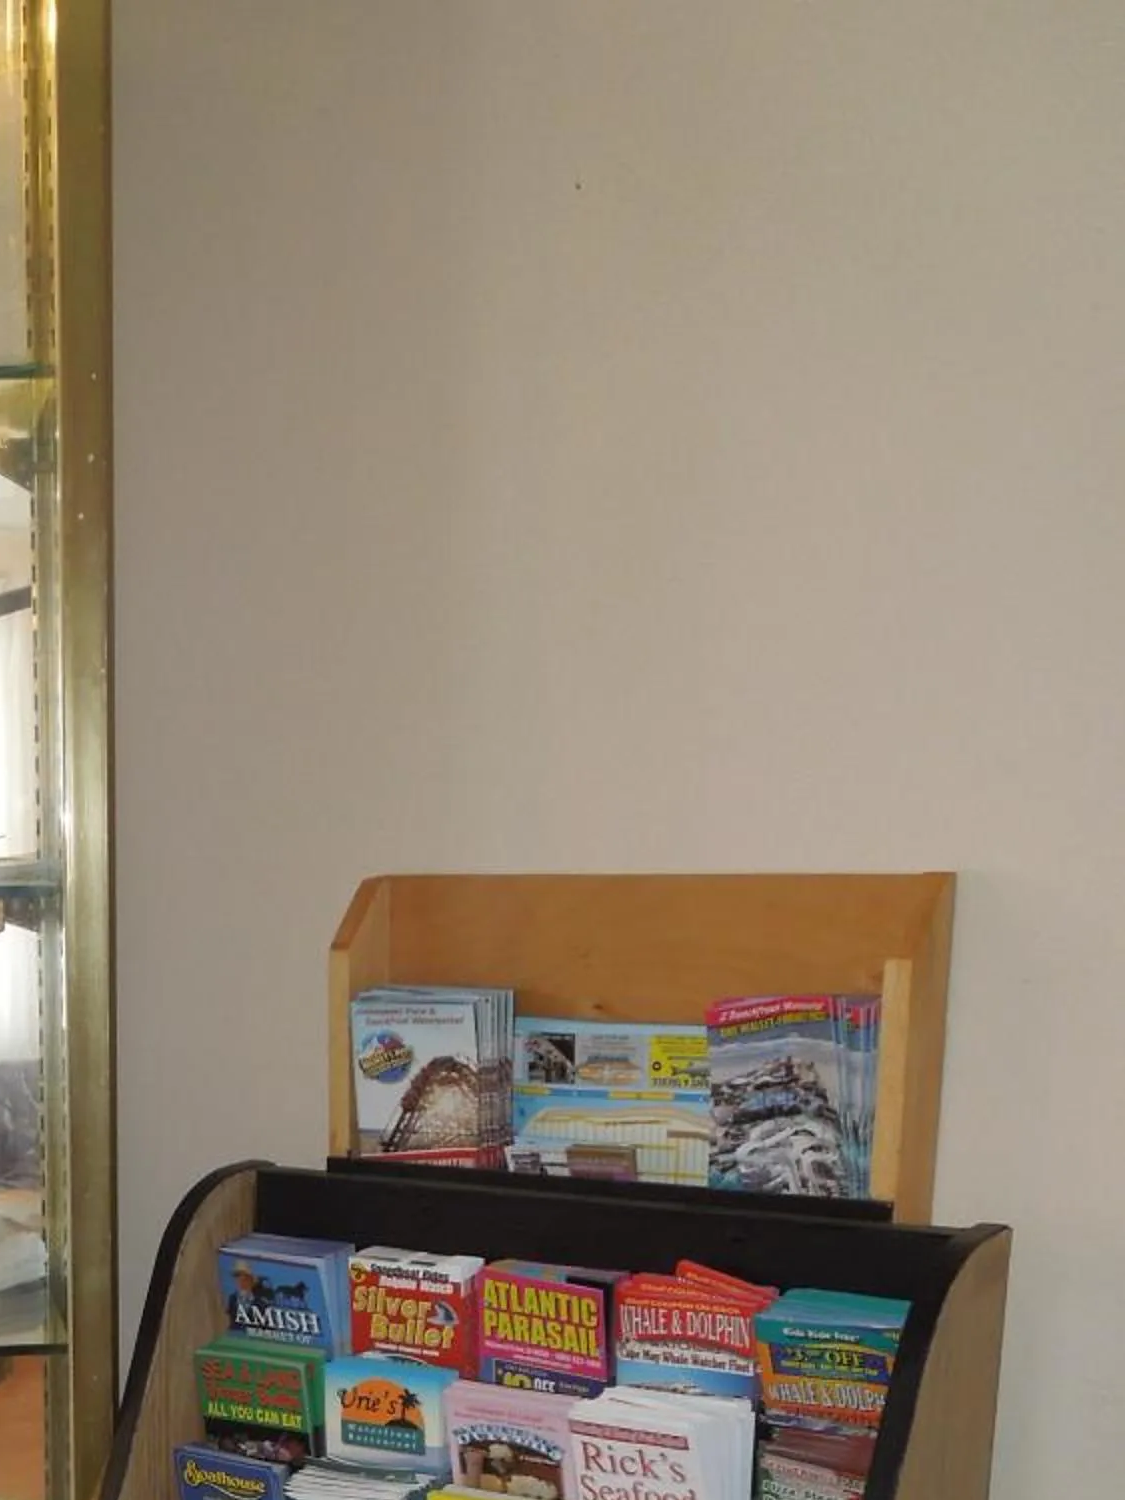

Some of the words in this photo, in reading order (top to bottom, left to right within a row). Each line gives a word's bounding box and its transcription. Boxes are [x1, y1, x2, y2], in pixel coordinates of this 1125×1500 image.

[234, 1302, 321, 1335] AMISH
[353, 1285, 432, 1320] Silver
[484, 1279, 598, 1327] ATLANTIC
[370, 1314, 456, 1349] Bullet
[484, 1310, 600, 1358] PARASAIL
[619, 1304, 669, 1340] WHALE
[671, 1309, 682, 1335] &
[686, 1311, 751, 1348] DOLPHIN
[767, 1383, 816, 1405] WHALE
[230, 1404, 254, 1419] YOU
[256, 1408, 280, 1425] CAN
[282, 1411, 303, 1429] EAT
[183, 1459, 266, 1492] Boathouse
[580, 1440, 687, 1483] Rick's
